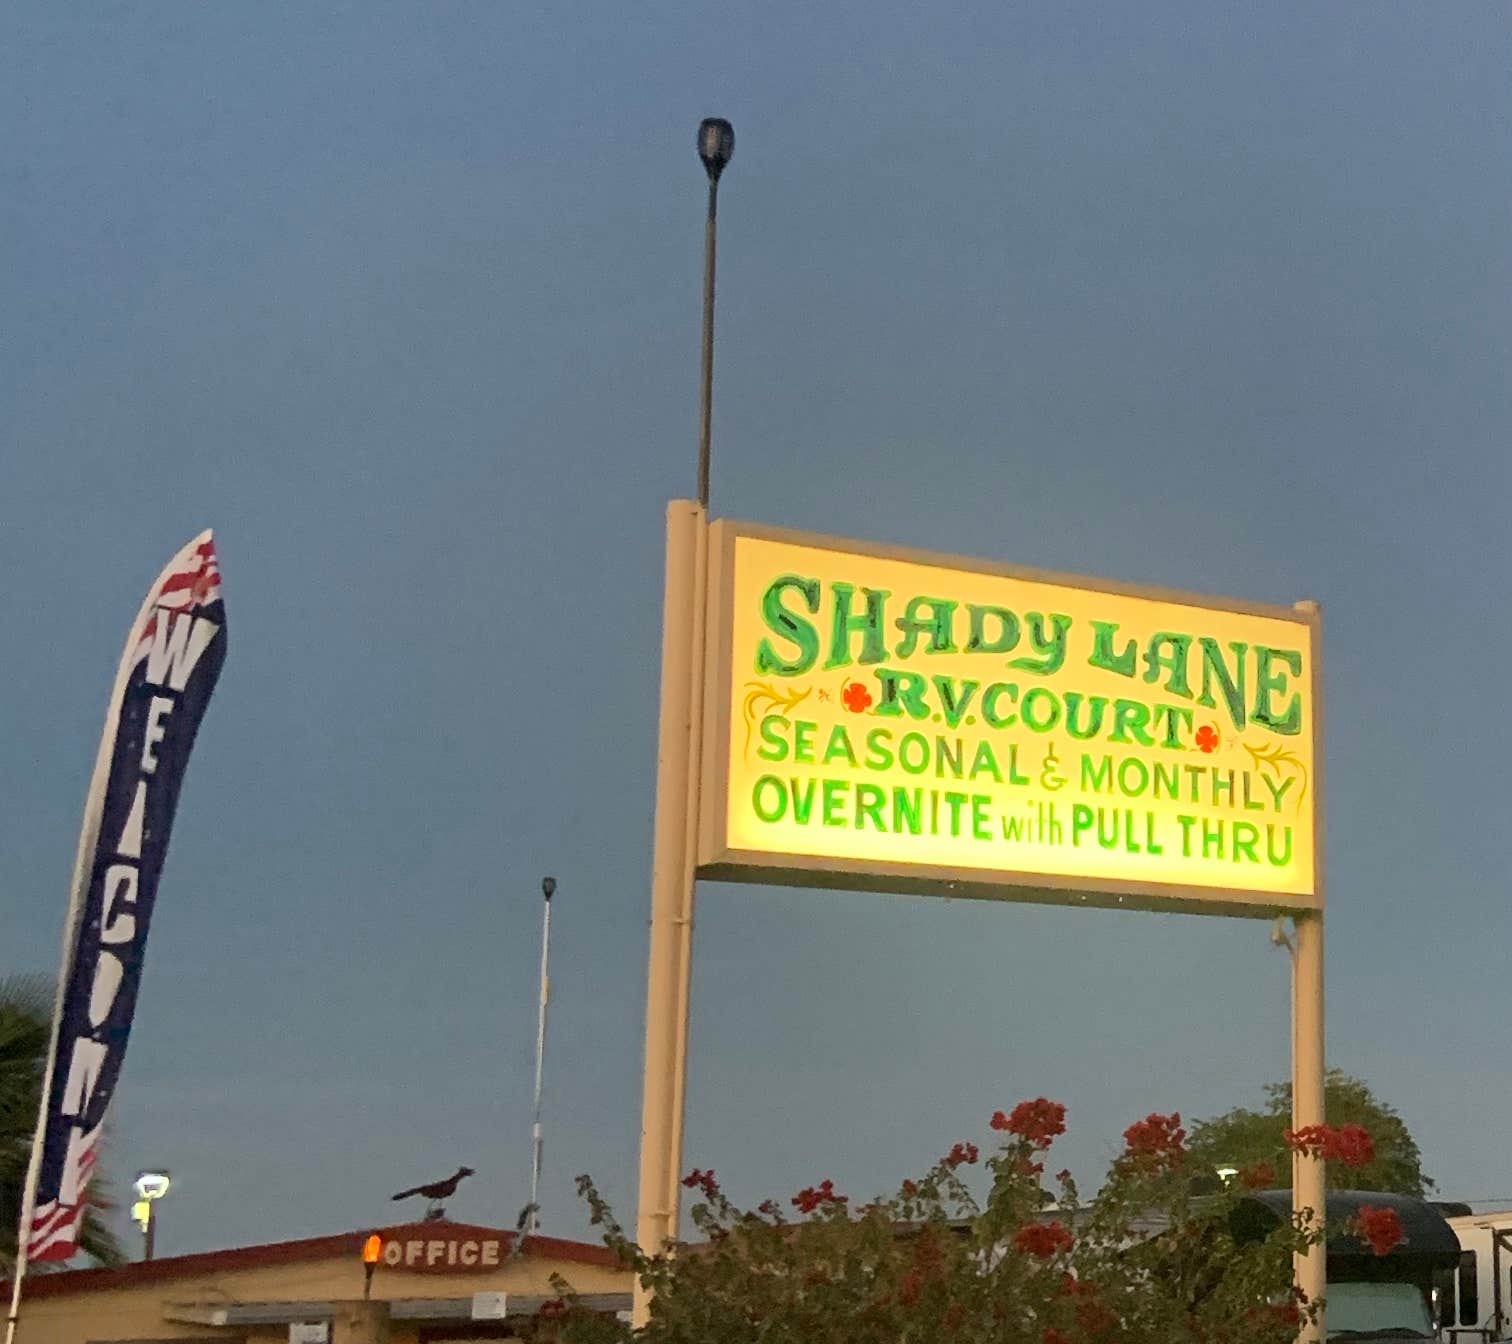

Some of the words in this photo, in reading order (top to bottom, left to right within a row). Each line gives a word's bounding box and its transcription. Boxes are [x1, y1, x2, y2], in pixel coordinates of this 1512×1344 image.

[753, 572, 1073, 678] SHADY
[1087, 619, 1303, 736] LANE
[756, 714, 1031, 786] SEASONAL
[1040, 741, 1068, 792] &
[1080, 753, 1297, 814] MONTHLY
[981, 682, 1195, 752] COURT
[751, 773, 993, 841] OVERNITE
[1001, 799, 1064, 846] with
[1071, 802, 1163, 856] PULL
[1176, 814, 1293, 867] THRU
[57, 607, 222, 1207] WECM
[383, 1239, 500, 1266] OFFICE
